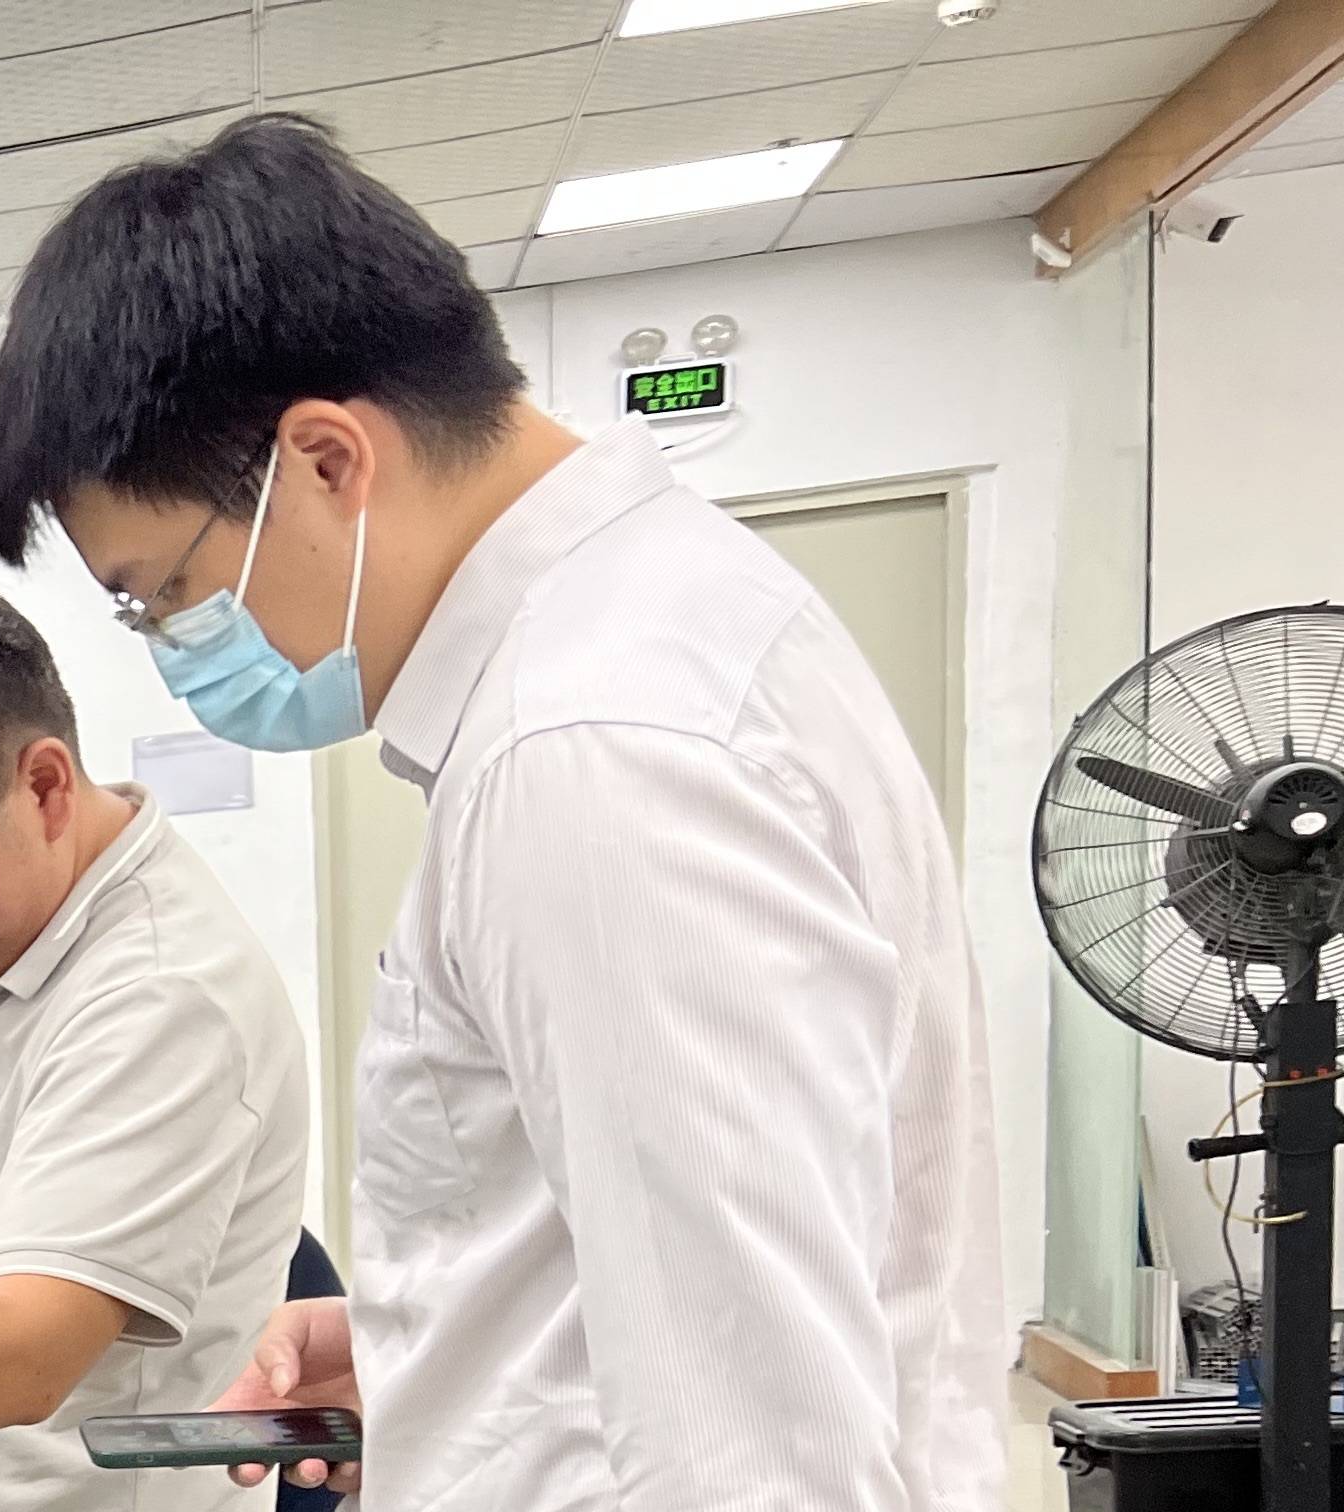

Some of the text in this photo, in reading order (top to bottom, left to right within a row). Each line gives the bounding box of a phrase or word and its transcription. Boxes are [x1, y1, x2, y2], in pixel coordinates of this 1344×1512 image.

[634, 367, 718, 398] 安全出口
[647, 394, 703, 411] EXIT
